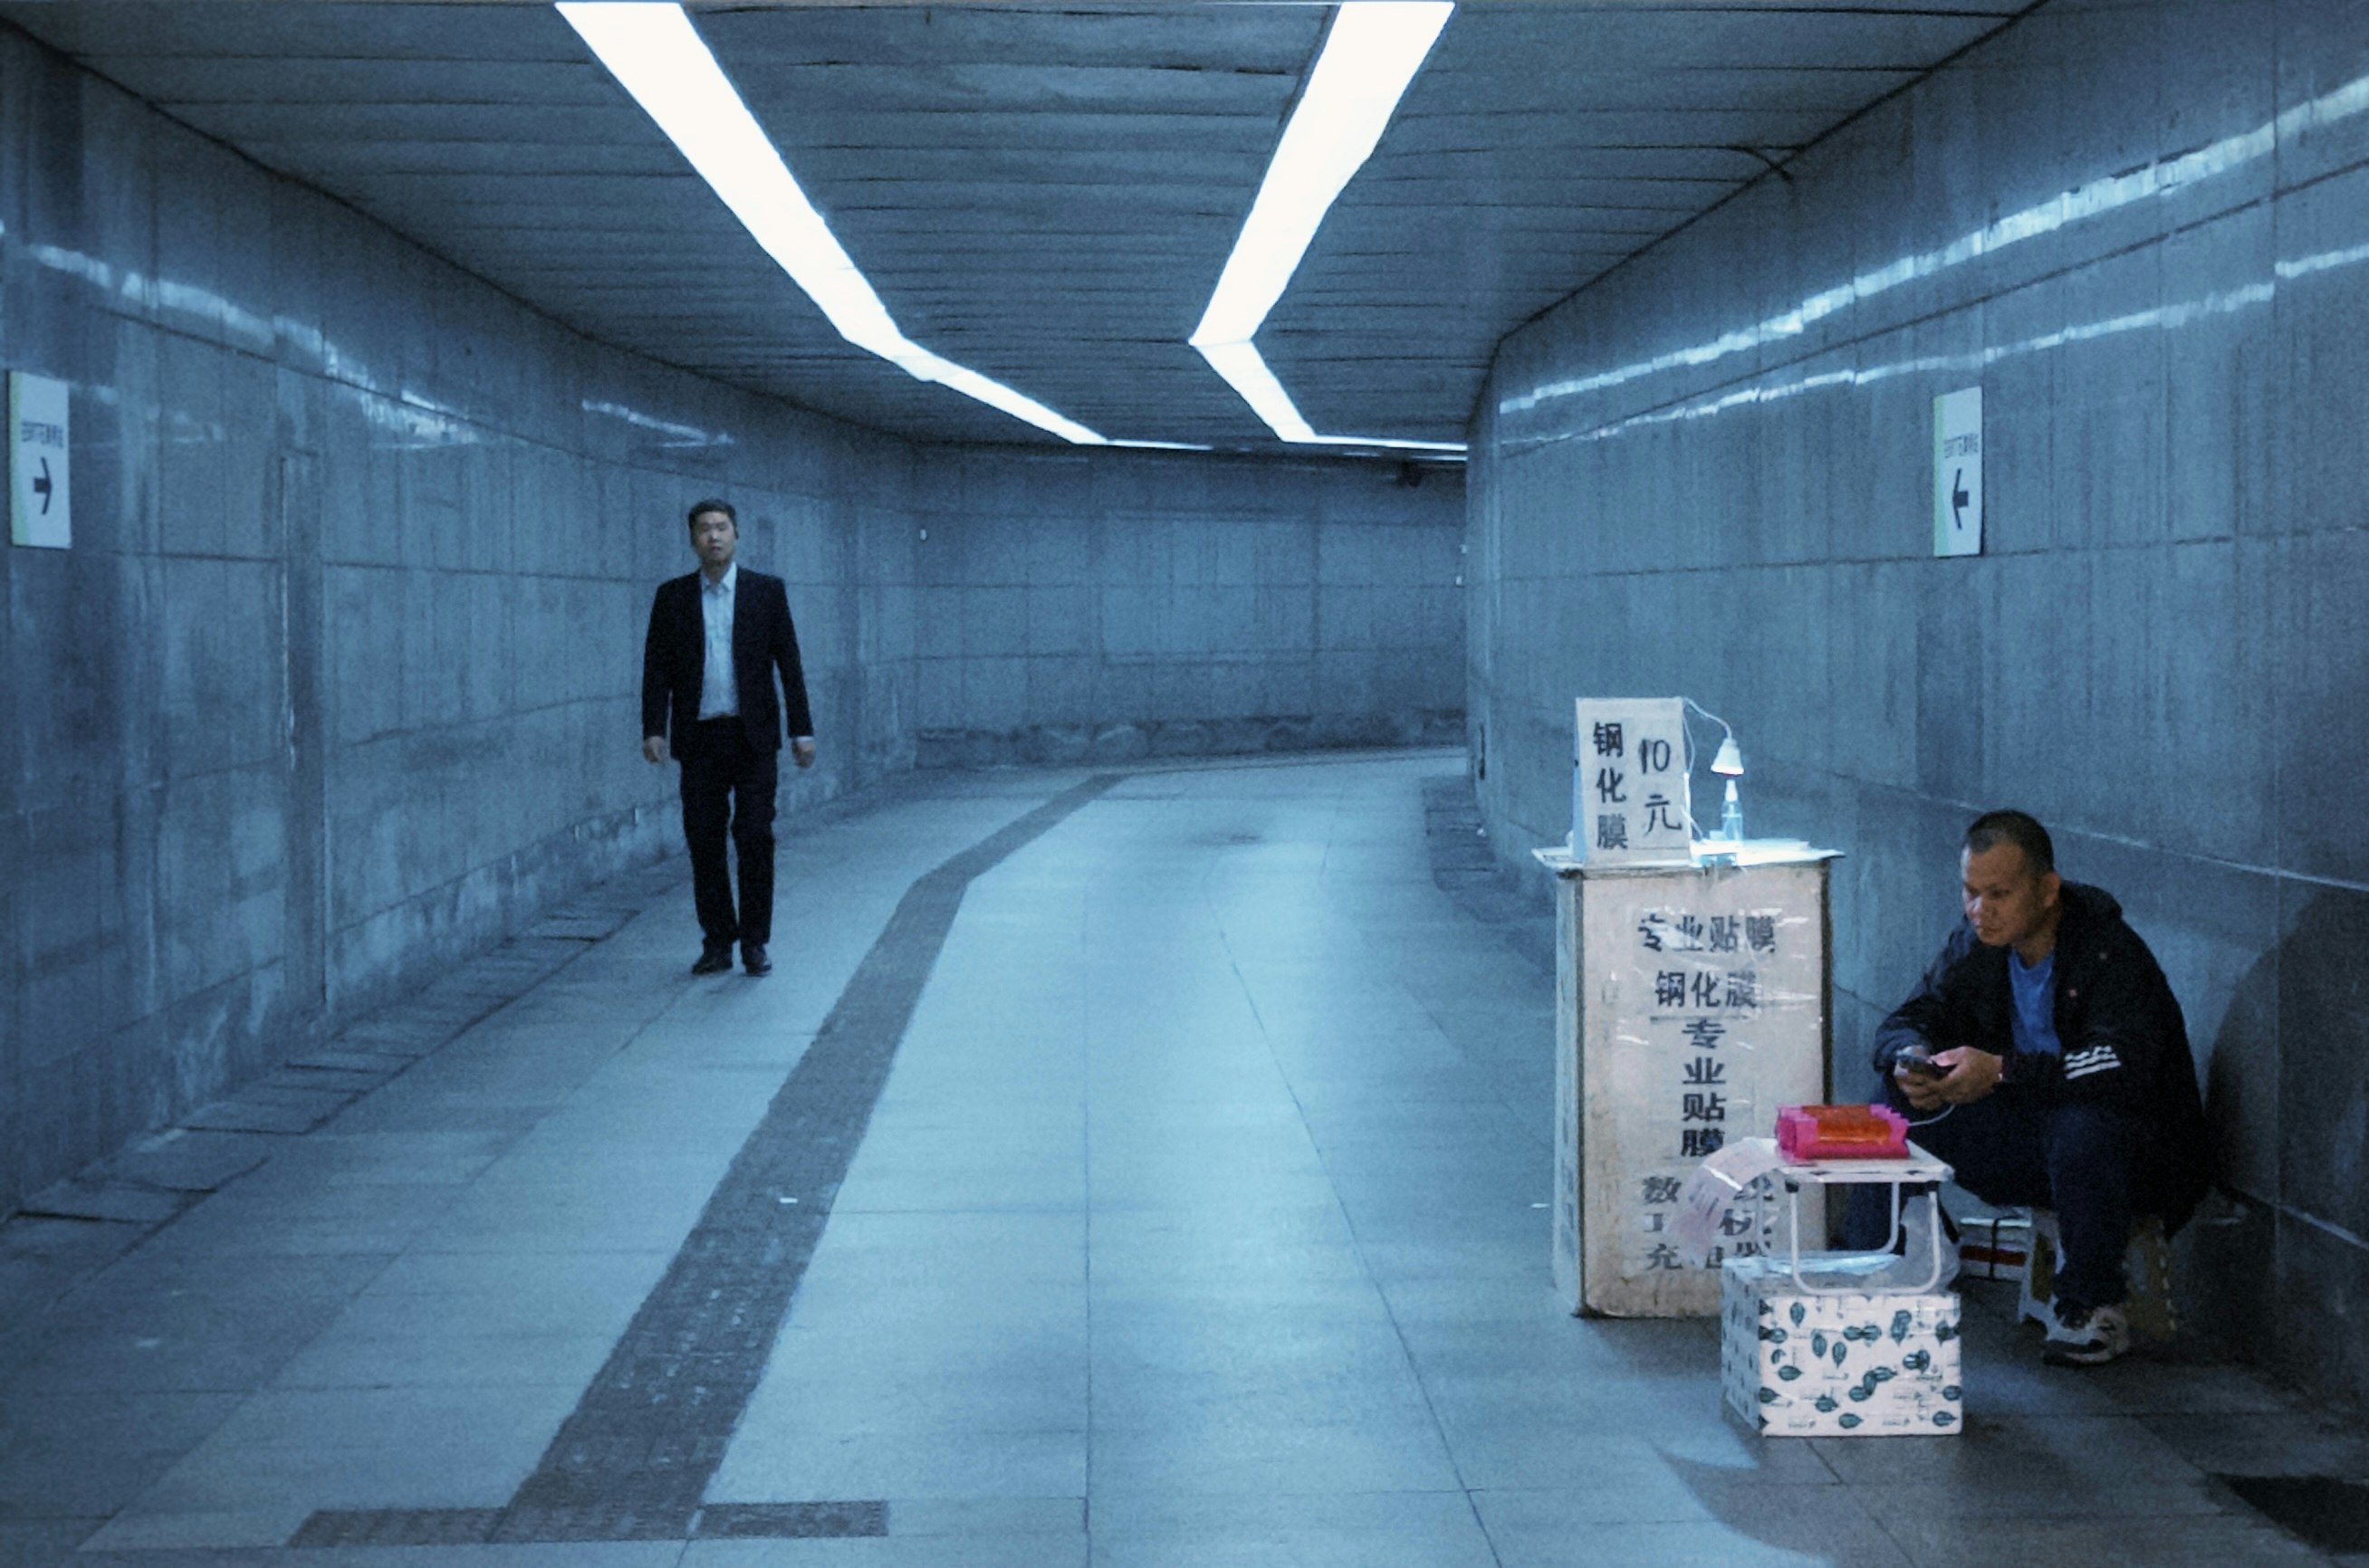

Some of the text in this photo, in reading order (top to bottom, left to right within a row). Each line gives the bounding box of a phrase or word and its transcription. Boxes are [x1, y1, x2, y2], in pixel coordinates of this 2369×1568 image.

[1593, 722, 1628, 850] 钢化膜
[1639, 739, 1682, 837] 10元
[1654, 970, 1758, 1009] 钢化膜
[1681, 1018, 1727, 1157] 专业贴膜
